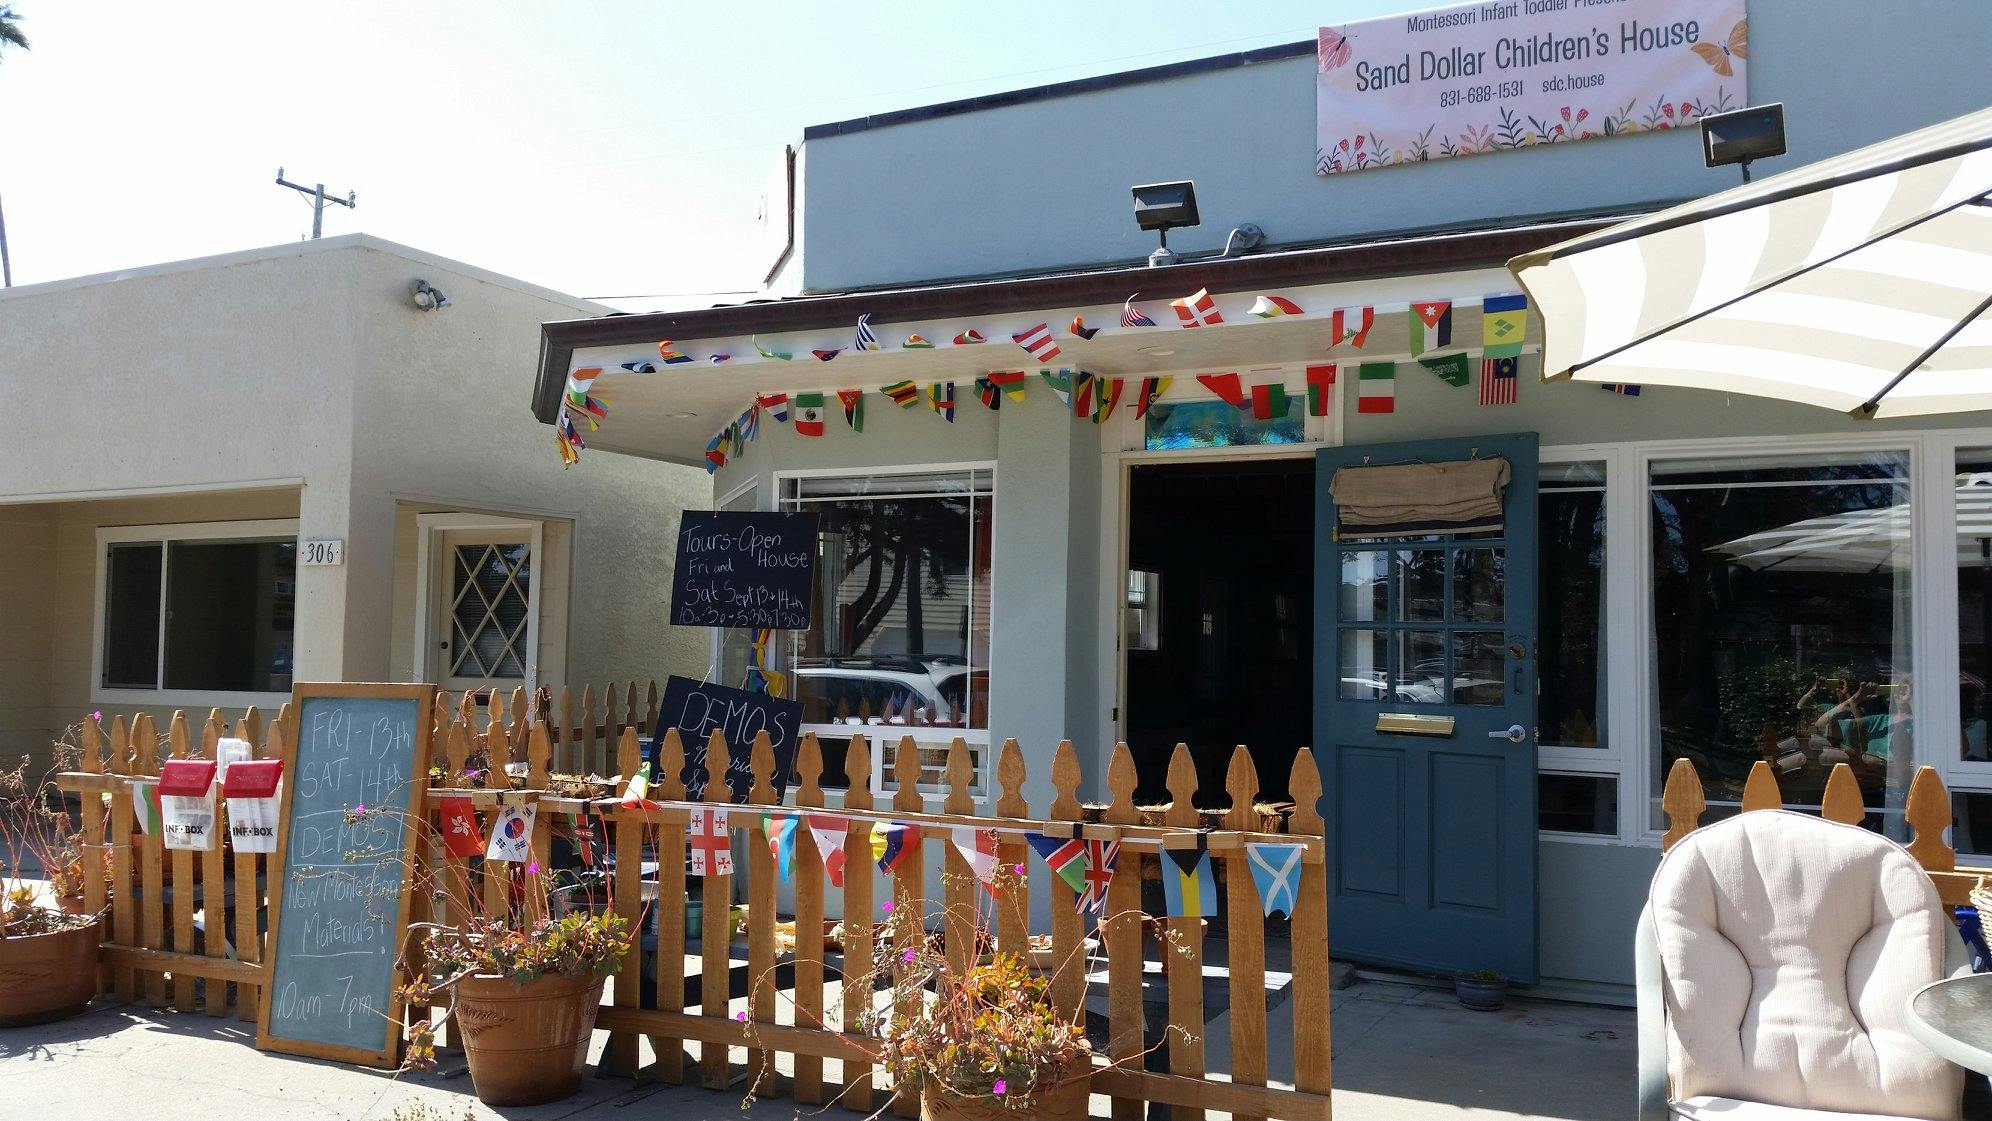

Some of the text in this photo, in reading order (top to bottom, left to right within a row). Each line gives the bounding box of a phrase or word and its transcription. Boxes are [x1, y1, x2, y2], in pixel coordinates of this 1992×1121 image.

[1407, 8, 1476, 34] Montessori
[1481, 1, 1519, 22] Infant
[1523, 0, 1568, 15] Toddler
[1356, 20, 1700, 92] Sand Dollar Children's House
[1440, 73, 1605, 108] 831-688-1531 sdc.house
[306, 543, 334, 563] 306
[689, 557, 735, 575] Fri and
[758, 549, 809, 568] House
[684, 580, 719, 606] Sat
[724, 580, 754, 608] Sept
[678, 692, 787, 748] DEMOS
[359, 762, 404, 805] 14th
[301, 815, 390, 858] DEMOS
[288, 879, 321, 909] New
